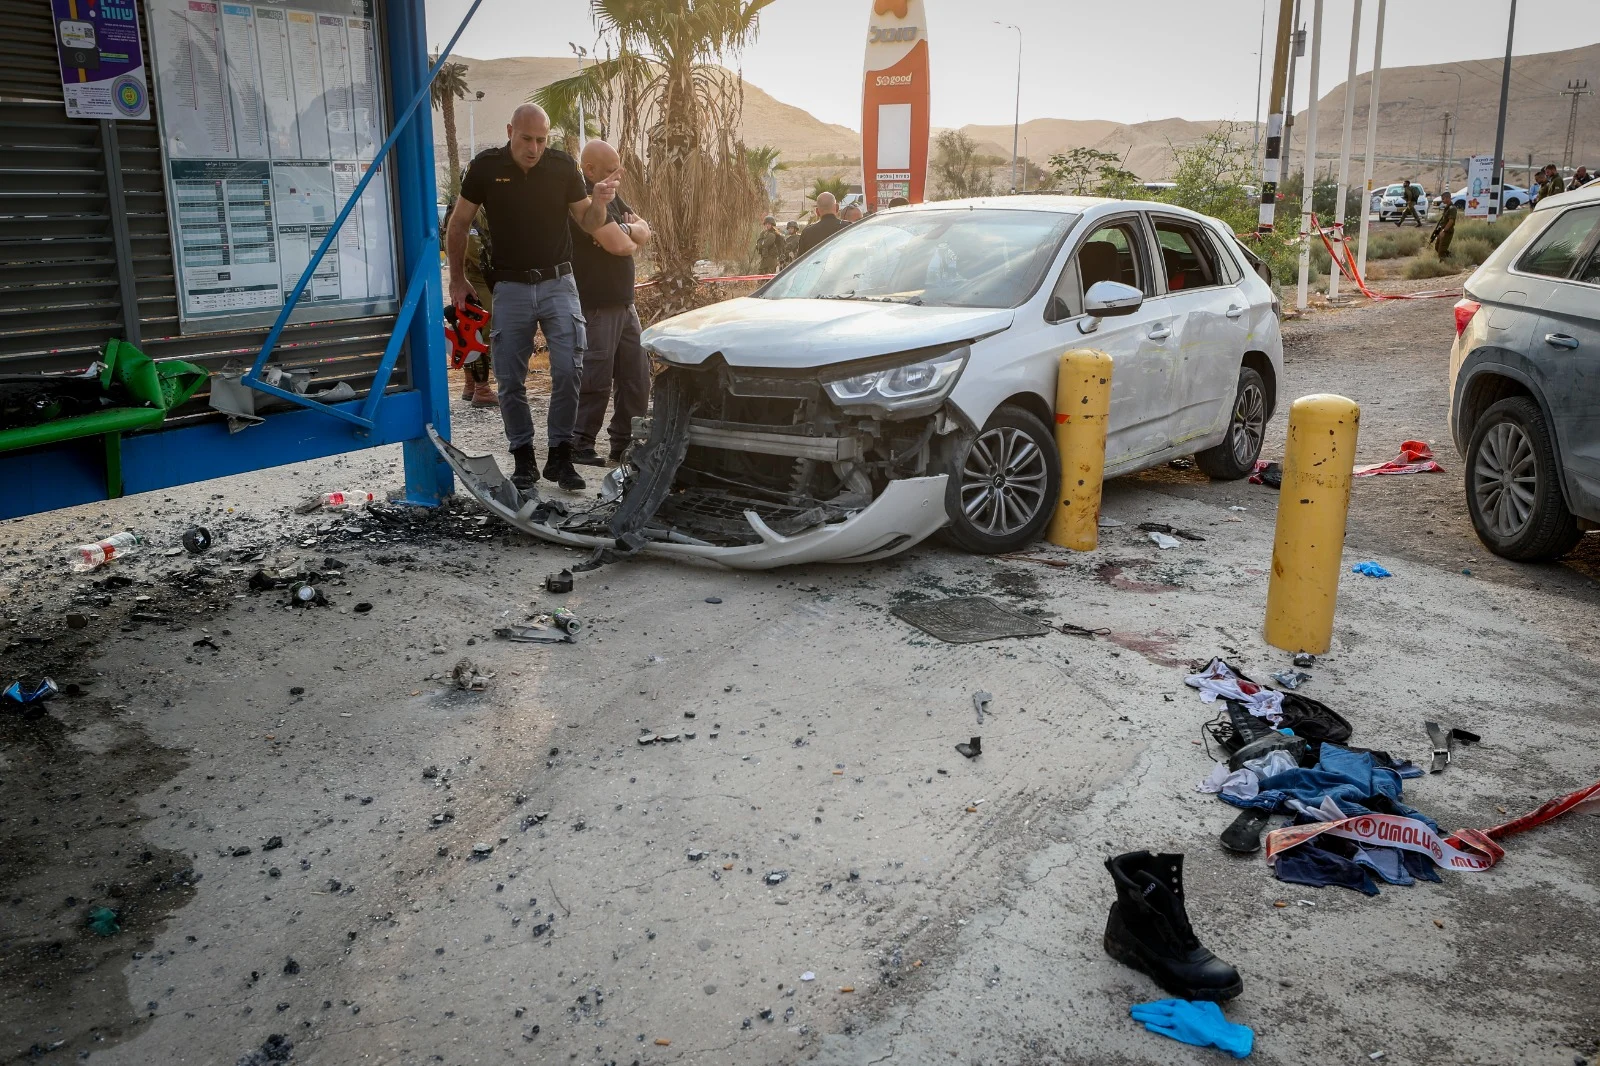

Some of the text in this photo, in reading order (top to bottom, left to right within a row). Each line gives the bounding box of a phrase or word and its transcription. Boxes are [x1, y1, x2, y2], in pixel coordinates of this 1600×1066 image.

[101, 6, 134, 21] שווה
[236, 7, 250, 15] 444
[269, 11, 282, 20] 486
[869, 26, 918, 43] סונול
[1450, 856, 1490, 869] ישרא
